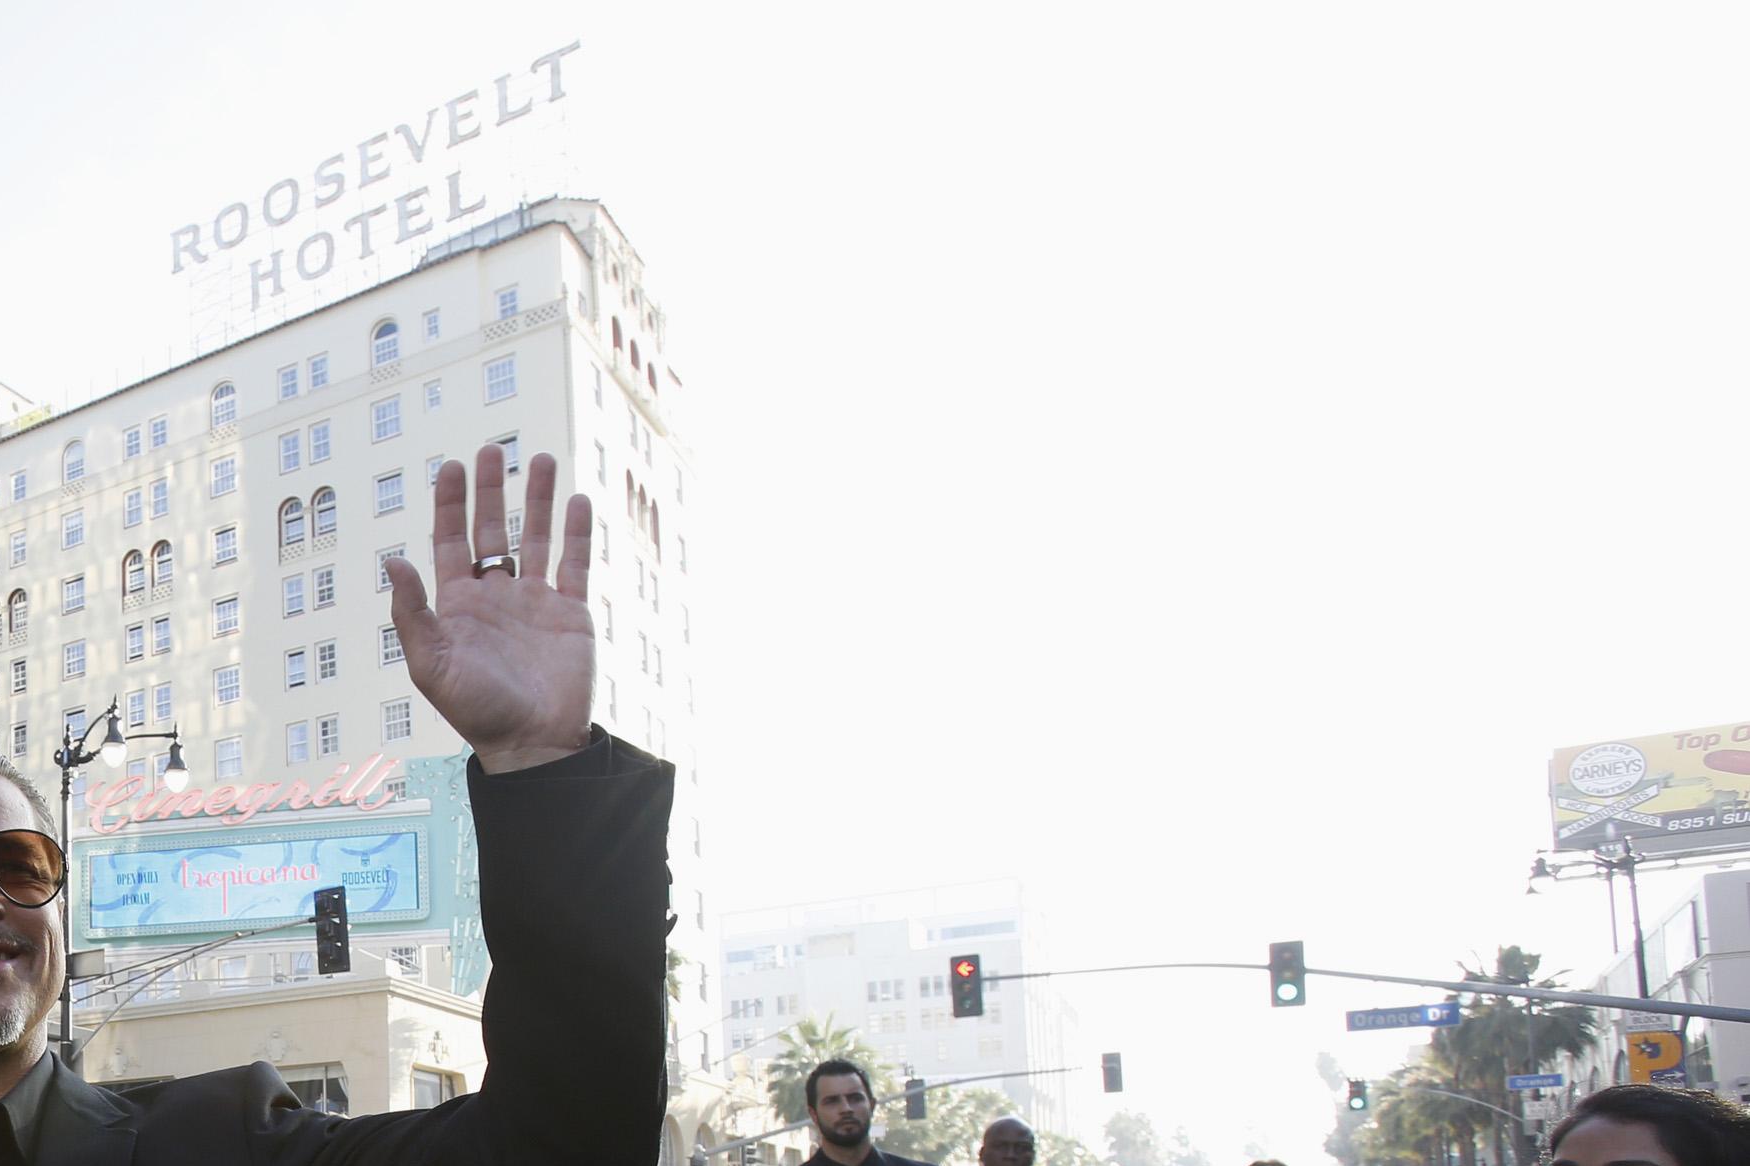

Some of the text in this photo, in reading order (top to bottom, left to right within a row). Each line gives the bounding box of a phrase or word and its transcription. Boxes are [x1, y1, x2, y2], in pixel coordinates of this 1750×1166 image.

[170, 38, 581, 274] ROOSEVELT
[249, 169, 487, 312] HOTEL
[1673, 732, 1722, 751] Top
[1572, 758, 1643, 780] CARNEYS
[84, 752, 401, 834] Cinegrill
[1585, 780, 1632, 794] LIMITED
[1565, 801, 1659, 825] HOT DOGS
[1567, 791, 1650, 833] HAMBURGERS
[1667, 811, 1750, 831] 8351 SU
[116, 871, 159, 886] OPEN DAILY
[180, 858, 320, 916] tropicana
[341, 867, 391, 885] ROOSEVELT
[1353, 1007, 1451, 1027] Orange Dr
